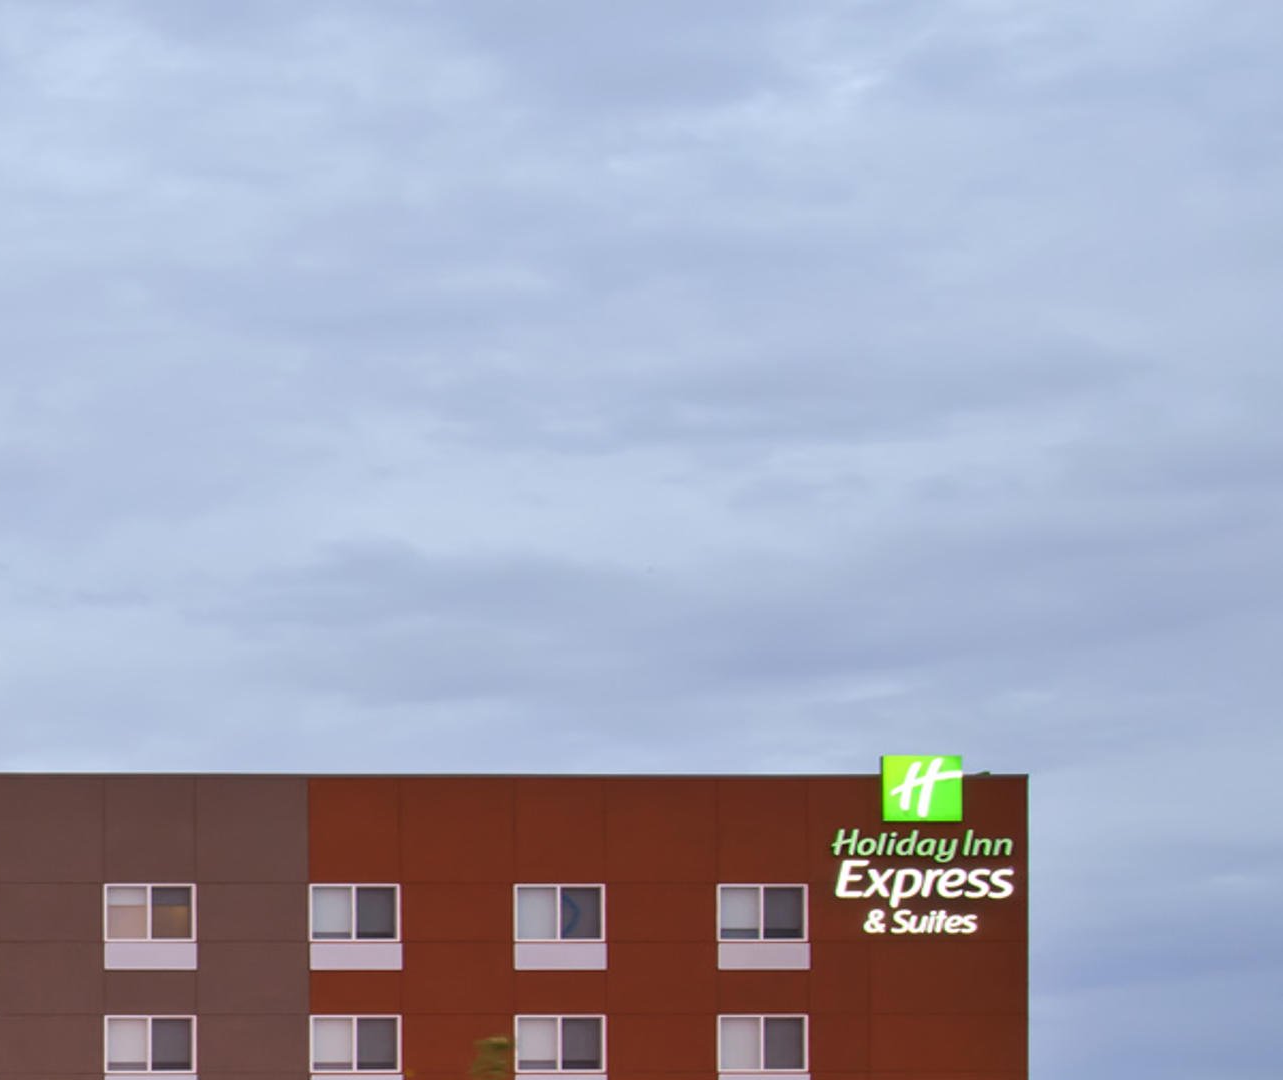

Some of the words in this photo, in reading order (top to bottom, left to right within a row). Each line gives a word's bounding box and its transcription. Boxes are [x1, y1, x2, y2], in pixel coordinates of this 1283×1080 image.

[831, 828, 958, 863] Holiday
[963, 829, 1013, 857] Inn
[834, 859, 1015, 908] Express
[863, 909, 886, 934] &
[890, 909, 978, 934] Suites
